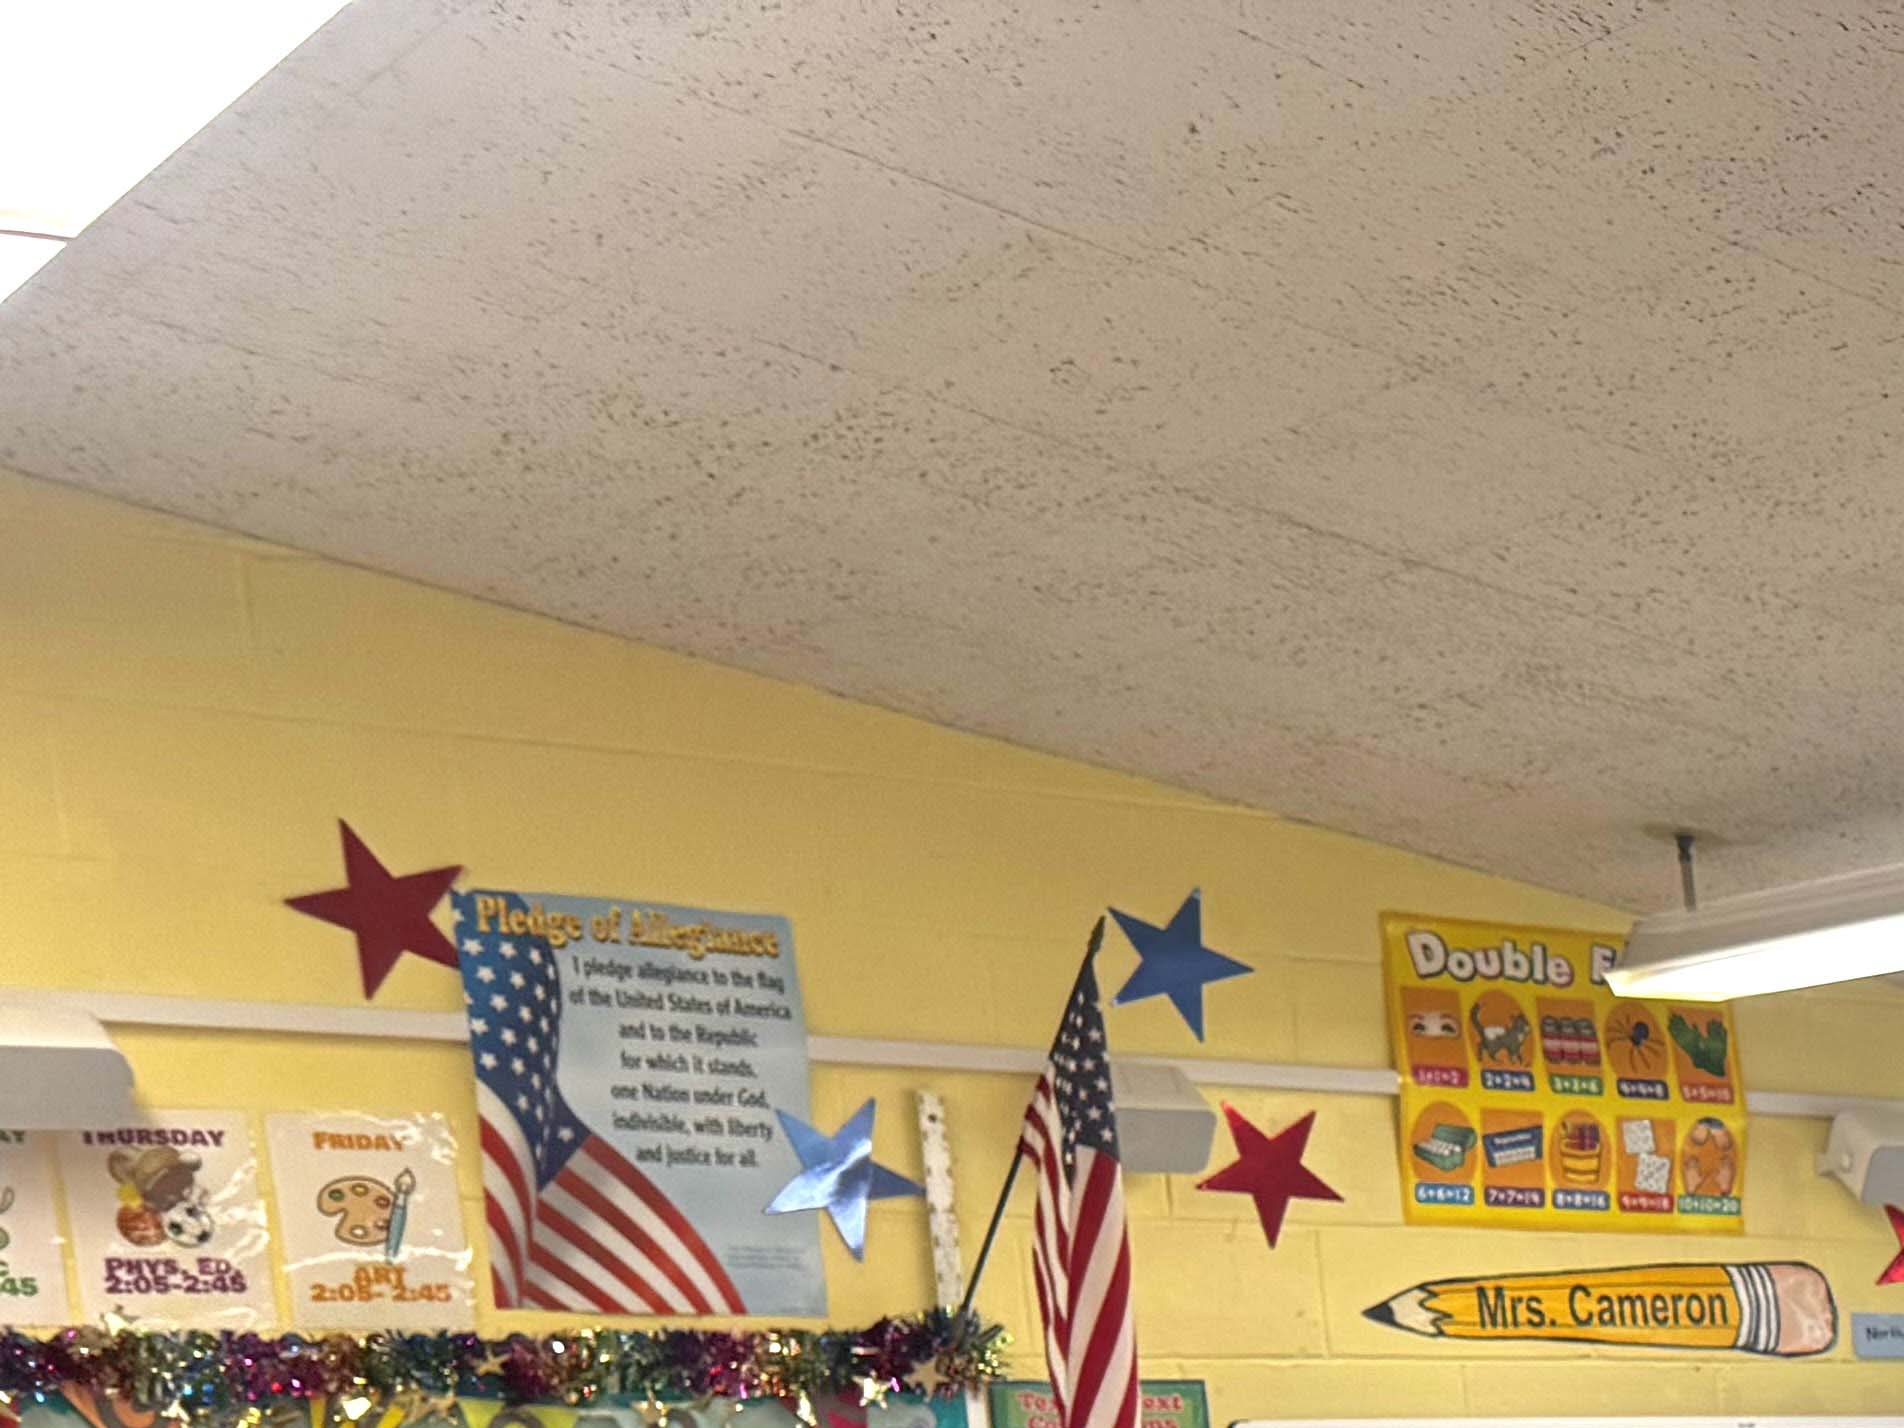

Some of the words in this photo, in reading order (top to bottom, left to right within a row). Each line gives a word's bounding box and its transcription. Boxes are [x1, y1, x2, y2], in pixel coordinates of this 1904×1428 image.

[475, 897, 582, 947] Pledge
[592, 907, 621, 942] of
[630, 910, 778, 961] Allegiance
[1407, 931, 1575, 987] Double
[584, 958, 631, 983] pledge
[638, 960, 709, 986] allegiance
[714, 968, 727, 985] to
[732, 967, 752, 988] the
[757, 969, 784, 994] flag
[569, 988, 584, 1006] of
[589, 989, 611, 1008] the
[616, 989, 662, 1011] United
[668, 992, 710, 1014] States
[716, 995, 731, 1016] of
[734, 998, 791, 1019] America
[619, 1021, 645, 1040] and
[650, 1025, 664, 1040] to
[670, 1024, 691, 1042] the
[695, 1026, 758, 1048] Republic
[621, 1052, 641, 1070] for
[646, 1054, 688, 1073] which
[692, 1057, 704, 1072] it
[611, 1086, 639, 1101] one
[642, 1083, 689, 1103] Nation
[693, 1086, 733, 1105] under
[695, 1115, 723, 1135] with
[728, 1116, 772, 1141] liberty
[312, 1132, 404, 1151] FRIDAY
[636, 1148, 662, 1163] and
[666, 1147, 711, 1168] justice
[715, 1148, 734, 1165] for
[105, 1257, 188, 1276] PHYS.
[352, 1266, 408, 1287] ART
[105, 1275, 248, 1295] 2:05-2:45
[1476, 1286, 1556, 1328] Mrs.
[1569, 1284, 1729, 1327] Cameron
